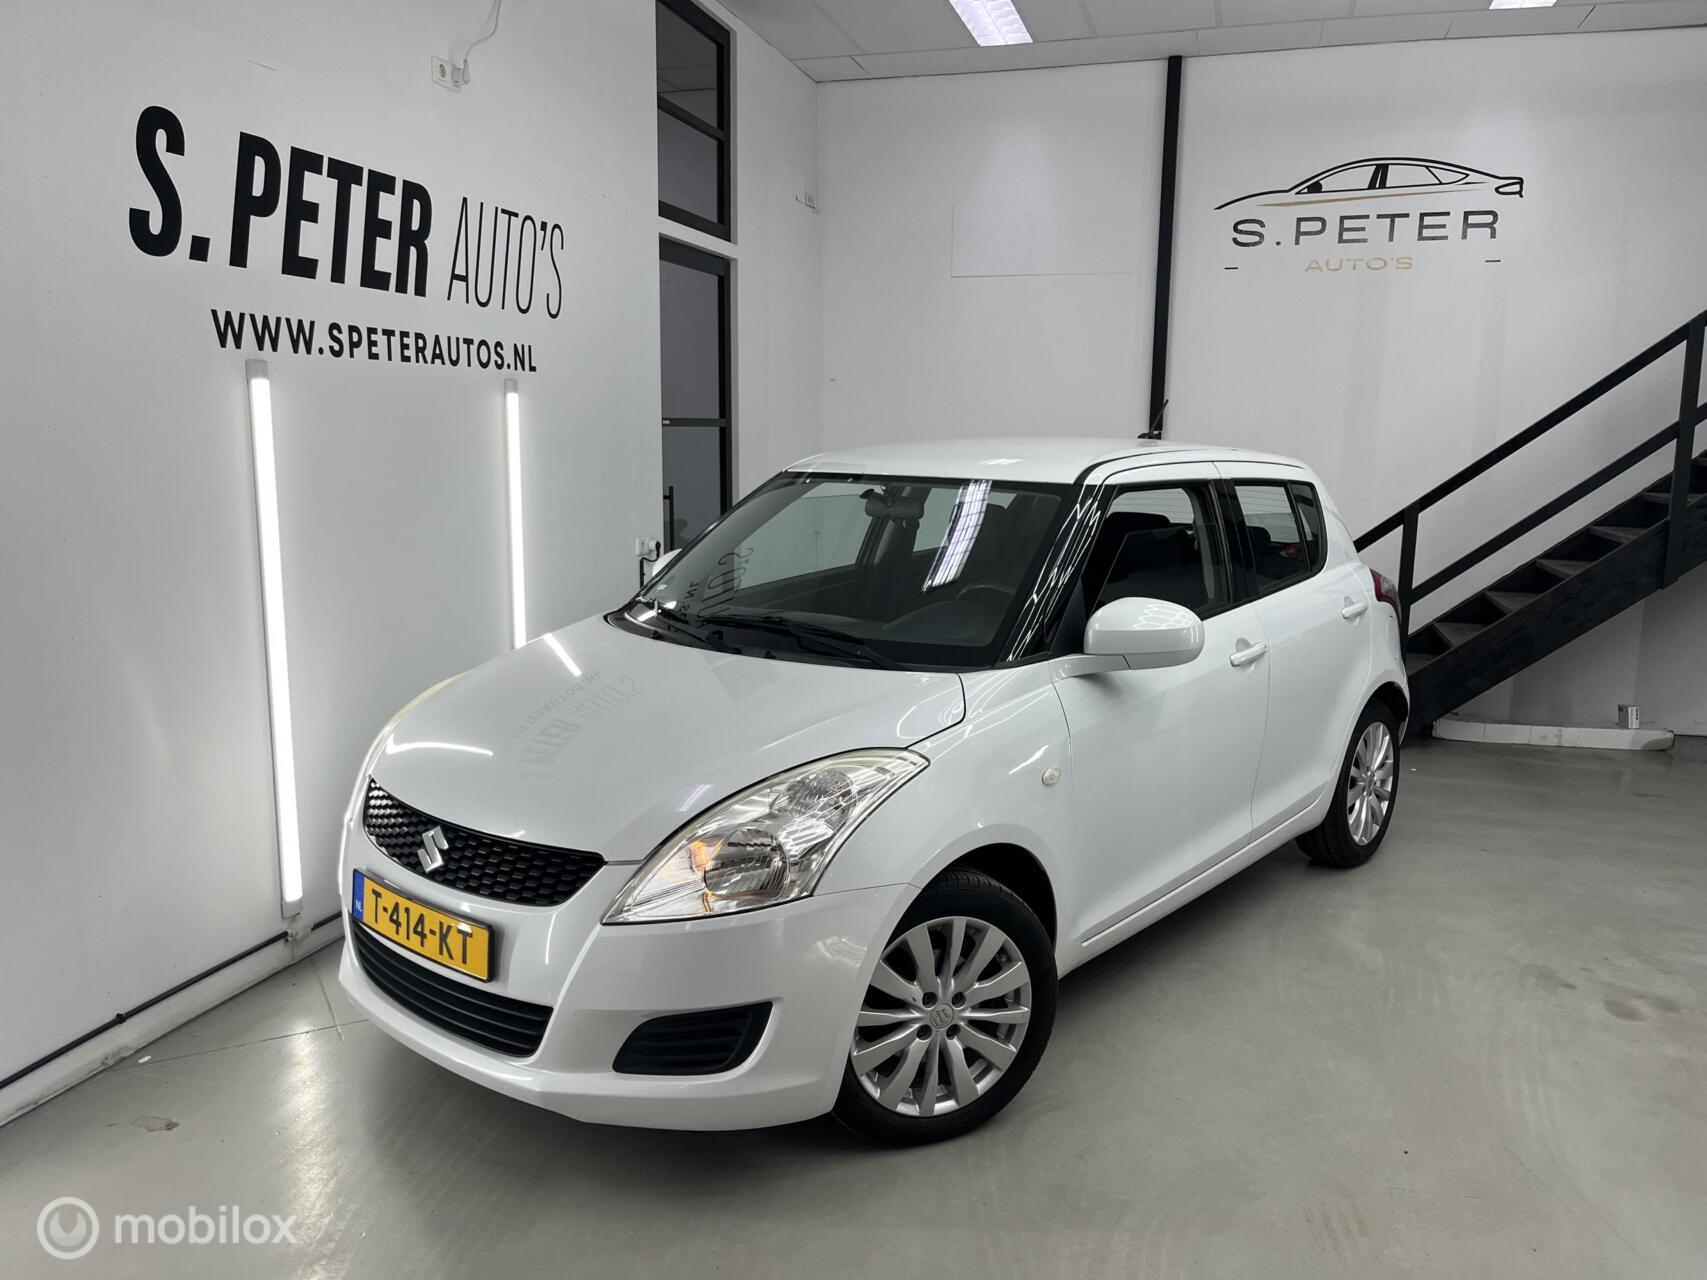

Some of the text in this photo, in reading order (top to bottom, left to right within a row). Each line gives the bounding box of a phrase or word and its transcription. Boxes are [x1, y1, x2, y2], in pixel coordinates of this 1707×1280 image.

[447, 196, 565, 320] AUTO'S
[1304, 256, 1414, 273] AUTO'S
[211, 308, 537, 373] WWW.SPETERAUTOS.NL
[355, 899, 363, 913] NL
[371, 888, 473, 965] T-414-KT
